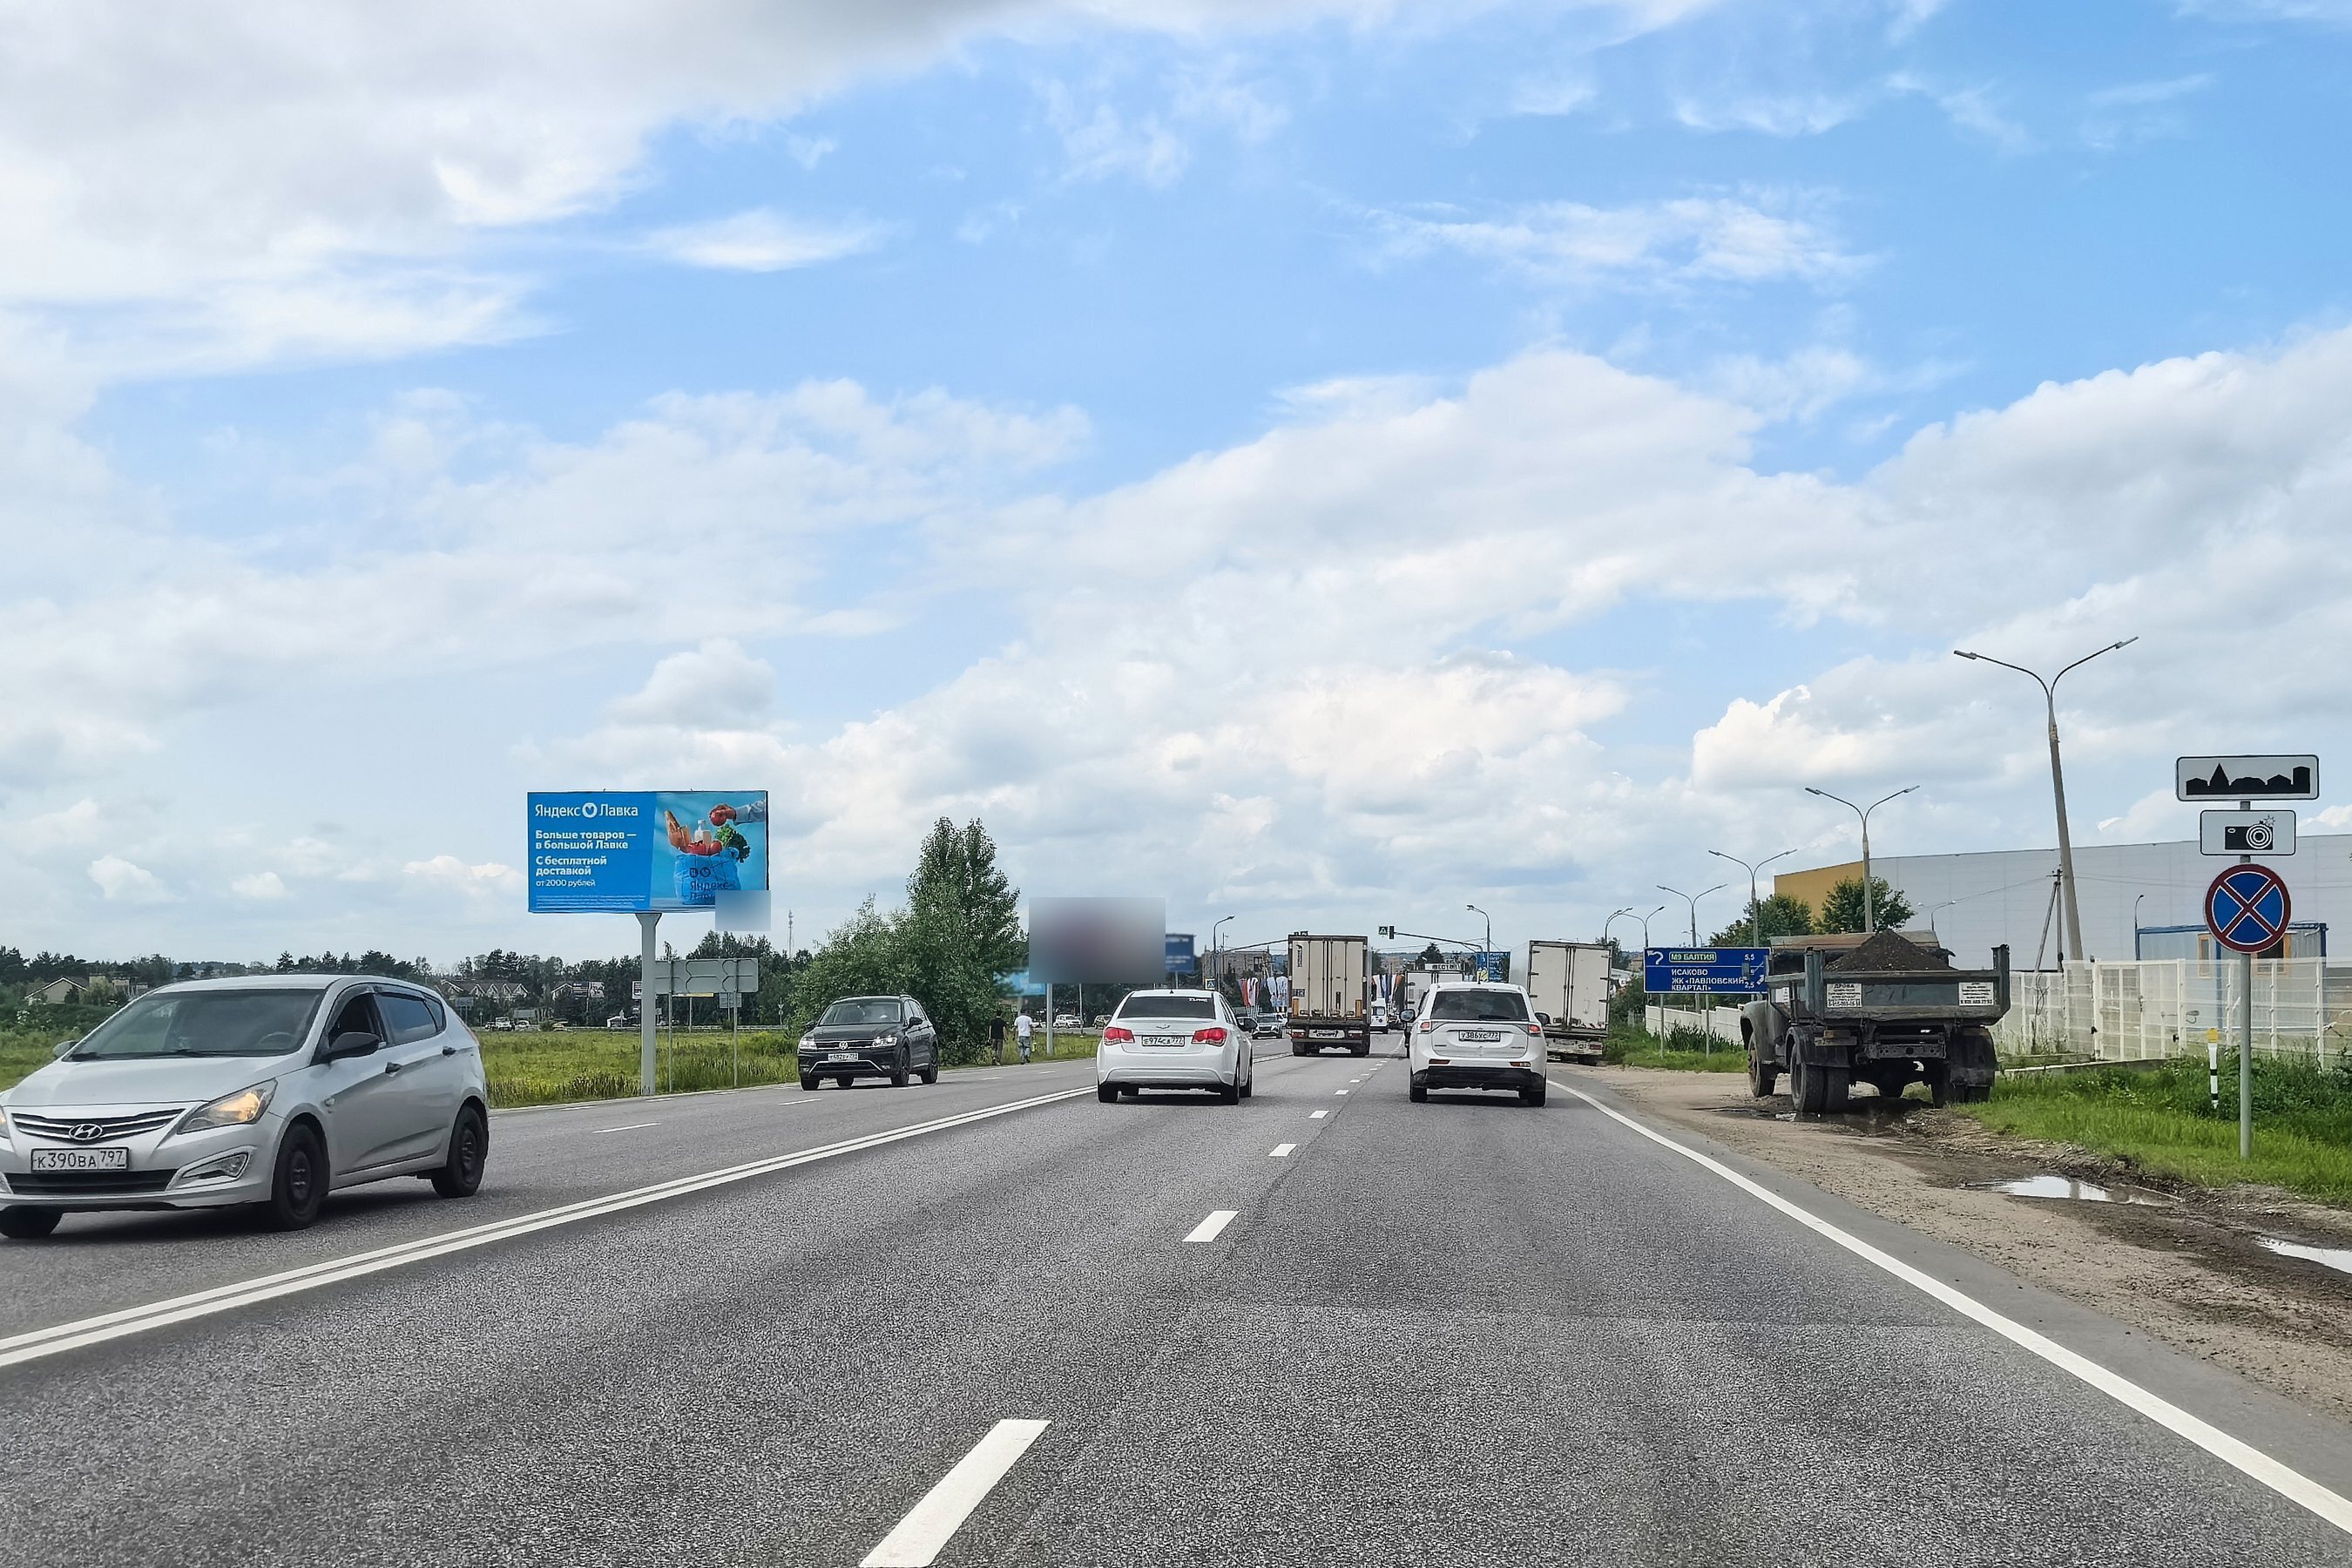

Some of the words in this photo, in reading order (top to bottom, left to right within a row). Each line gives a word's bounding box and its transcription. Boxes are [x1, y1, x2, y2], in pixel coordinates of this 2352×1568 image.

[535, 804, 581, 819] Яндекс
[599, 803, 639, 816] Лавка
[535, 830, 578, 840] Больше
[579, 832, 625, 841] товаров
[544, 840, 593, 849] большой
[595, 840, 628, 849] Лавке
[536, 855, 544, 865] С
[544, 855, 607, 865] бесплатной
[535, 866, 591, 876] доставкой
[690, 881, 728, 891] Яндекс
